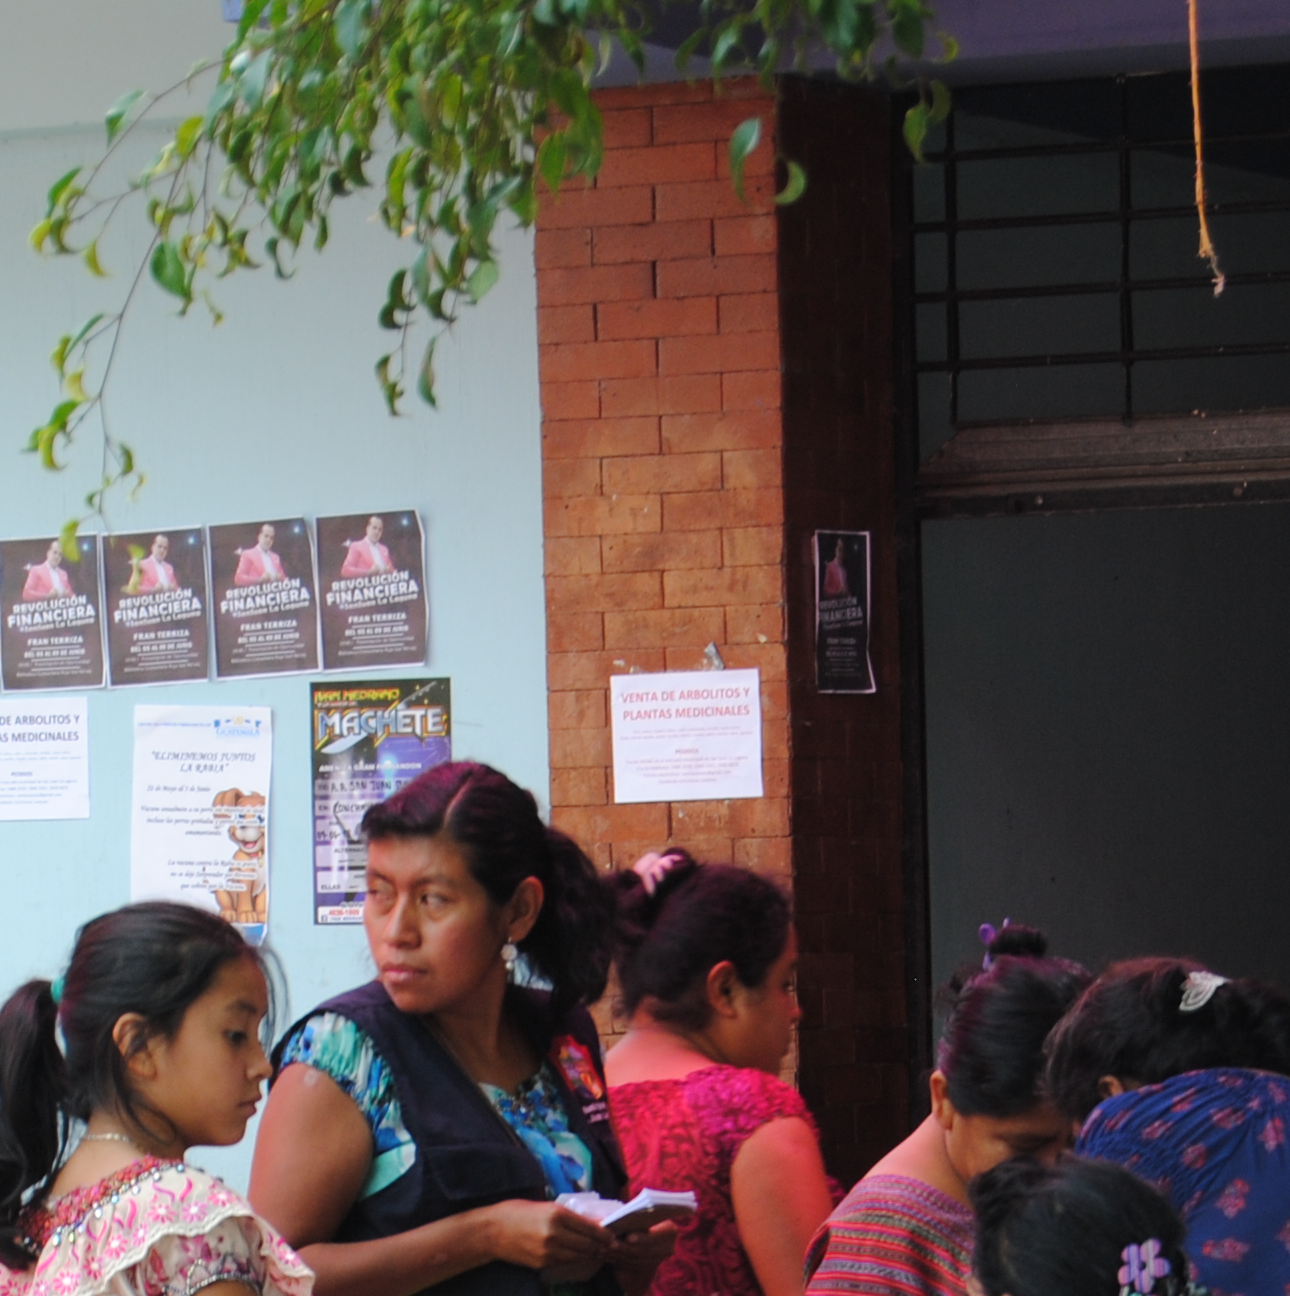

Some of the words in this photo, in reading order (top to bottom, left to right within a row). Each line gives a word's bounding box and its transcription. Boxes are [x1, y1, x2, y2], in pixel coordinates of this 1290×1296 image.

[225, 577, 300, 600] REVOLUCIÓN
[331, 570, 409, 591] REVOLUCIÓN
[118, 587, 191, 609] REVOLUCIÓN
[219, 586, 310, 614] FINANCIERA
[326, 579, 419, 606] FINANCIERA
[13, 594, 86, 614] REVOLUCIÓN
[113, 596, 201, 623] FINANCIERA
[7, 603, 95, 628] FINANCIERA
[621, 692, 658, 704] VENTA
[661, 691, 675, 701] DE
[679, 688, 740, 700] ARBOLITOS
[743, 687, 750, 697] Y
[0, 716, 11, 726] DE
[15, 714, 71, 725] ARBOLITOS
[73, 714, 80, 724] Y
[623, 708, 672, 721] PLANTAS
[675, 704, 750, 718] MEDICINALES
[315, 706, 447, 744] MACHETE
[11, 731, 79, 742] MEDICINALES
[179, 763, 192, 772] LA
[220, 753, 255, 762] JUNTOS
